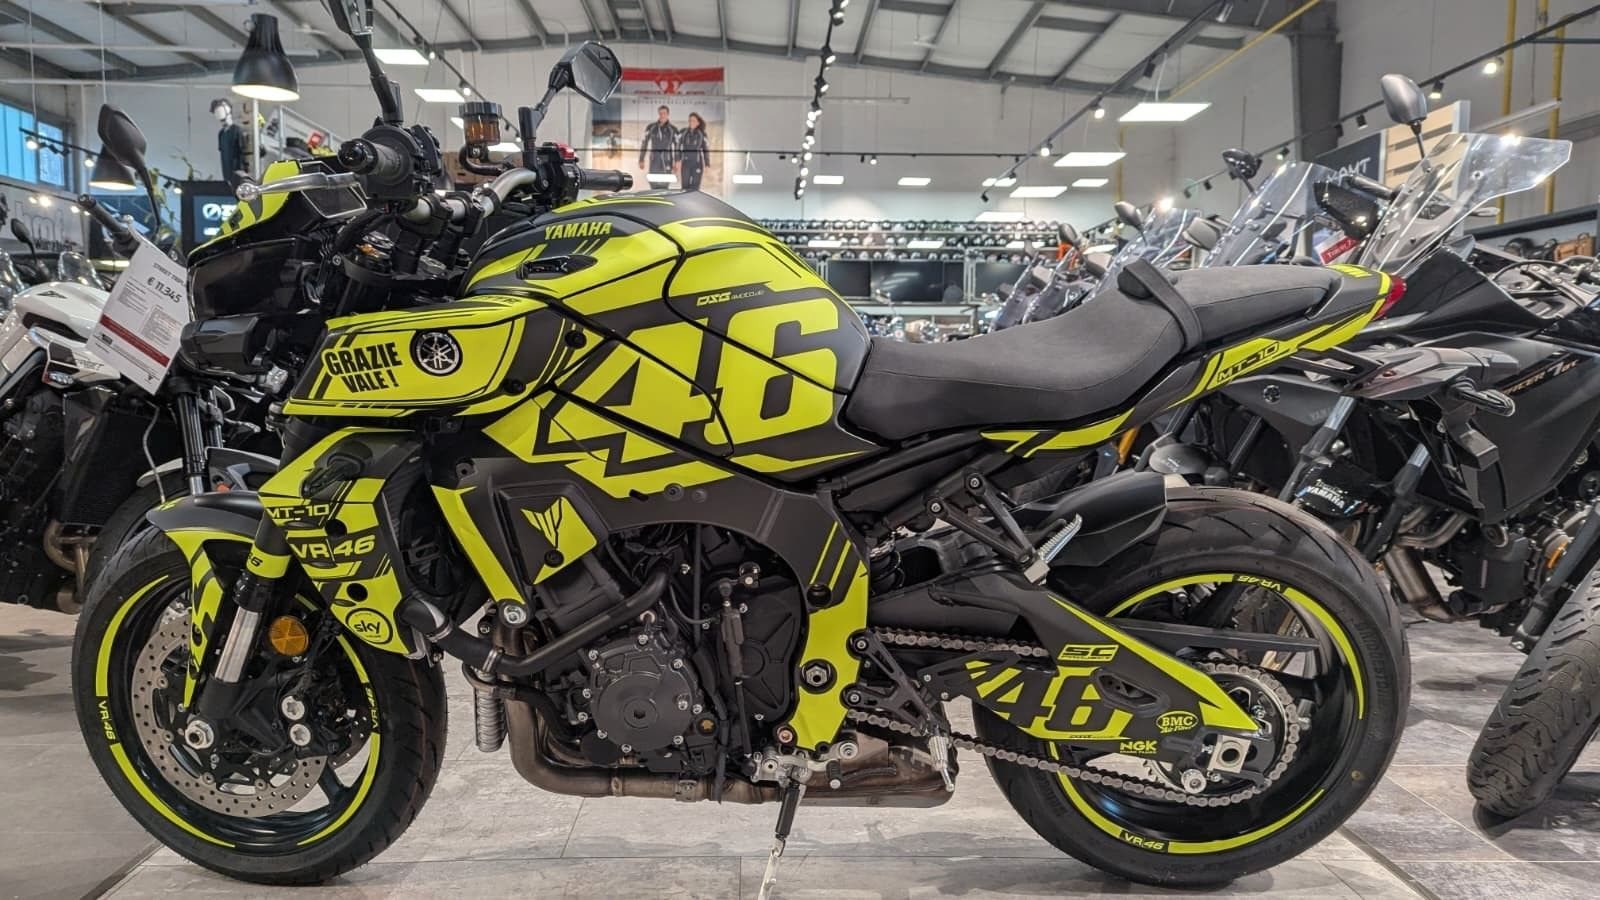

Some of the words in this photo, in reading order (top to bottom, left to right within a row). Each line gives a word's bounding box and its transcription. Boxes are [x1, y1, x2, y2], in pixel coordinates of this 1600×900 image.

[544, 222, 613, 240] YAMAHA
[154, 279, 183, 304] 11.345
[324, 342, 402, 376] GRAZIE
[1217, 341, 1279, 382] MT-10
[547, 298, 838, 463] 46
[1306, 485, 1345, 509] YAMAHA
[265, 503, 330, 519] MT-10
[1237, 575, 1281, 591] VR46
[354, 620, 380, 634] sky
[978, 667, 1116, 732] 46
[98, 700, 117, 740] VR46
[1162, 716, 1193, 727] BMC
[1119, 740, 1158, 751] NGK
[1124, 832, 1166, 850] VR46
